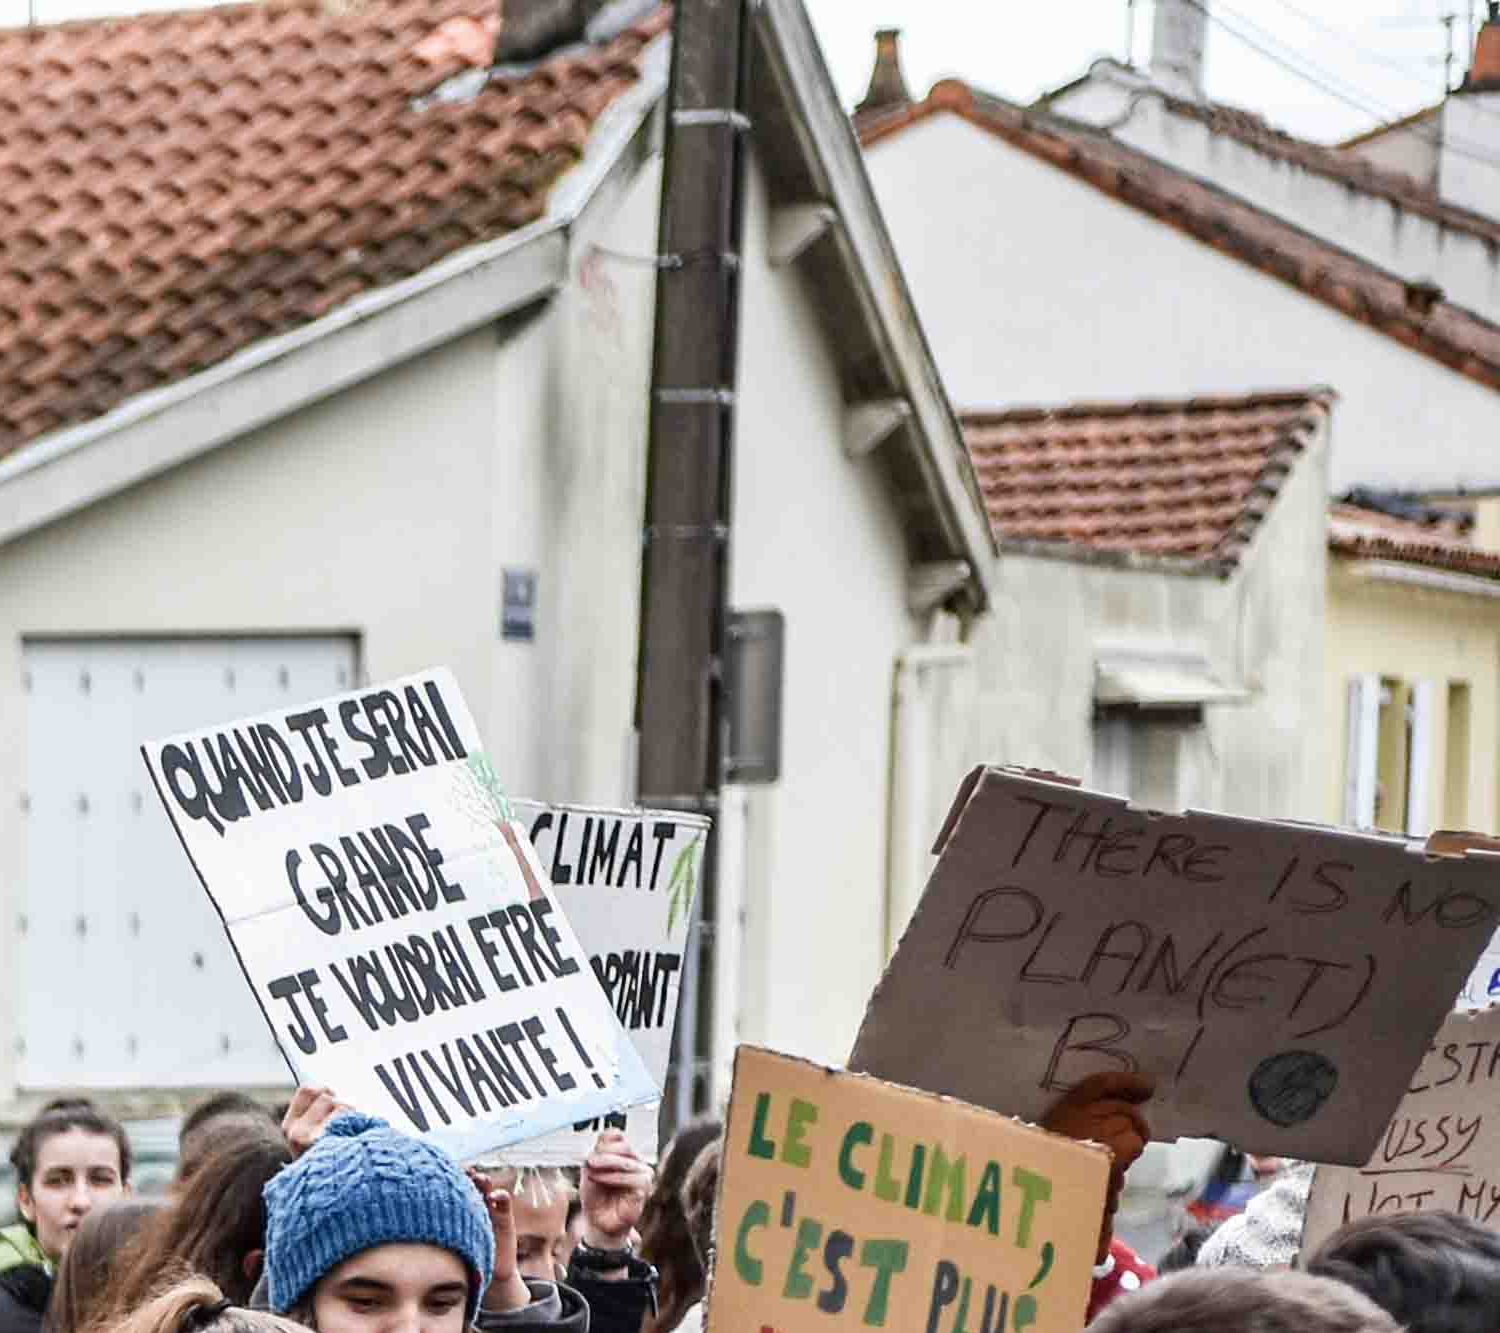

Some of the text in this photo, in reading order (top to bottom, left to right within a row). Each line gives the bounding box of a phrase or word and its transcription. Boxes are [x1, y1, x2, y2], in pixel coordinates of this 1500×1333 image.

[160, 680, 468, 836] QUAND JE SERAI
[284, 813, 467, 936] GRANDE
[528, 812, 676, 891] CLIMAT
[1011, 797, 1494, 929] THERE IS NO
[266, 899, 580, 1056] JE VOUDRAI ETRE
[374, 1013, 577, 1133] VIVANTE
[747, 1092, 1055, 1290] LE CLIMAT,
[733, 1191, 909, 1327] C'EST
